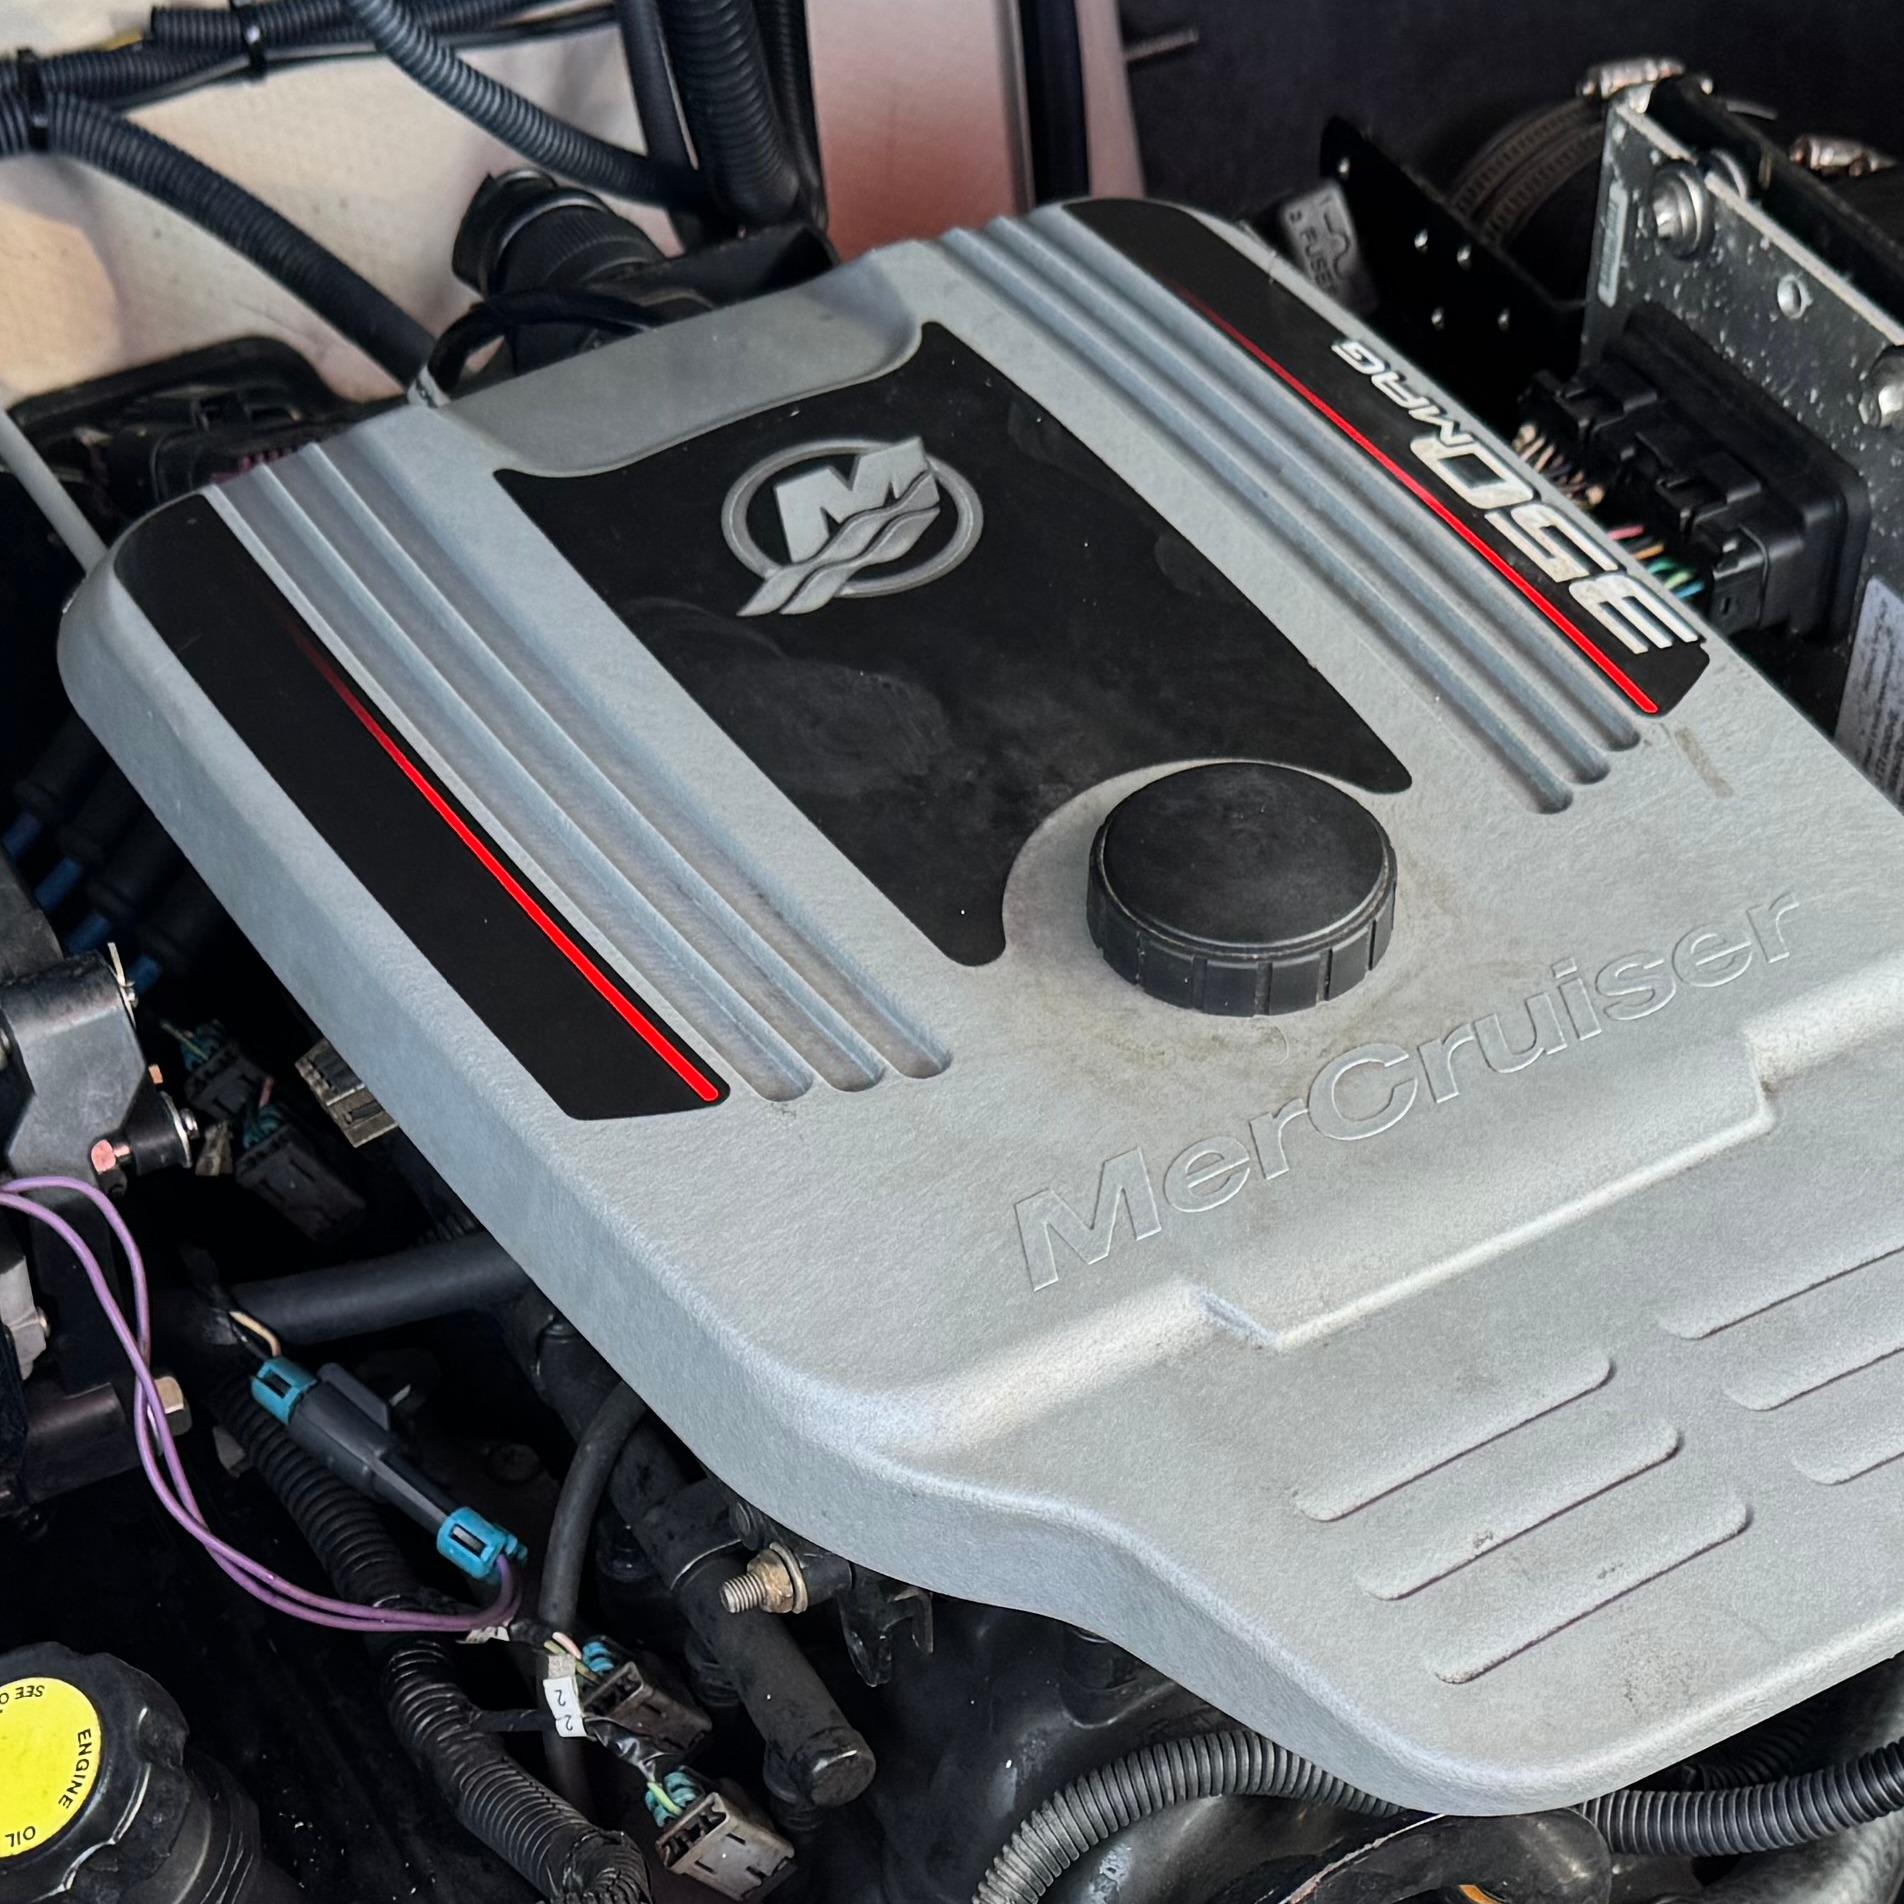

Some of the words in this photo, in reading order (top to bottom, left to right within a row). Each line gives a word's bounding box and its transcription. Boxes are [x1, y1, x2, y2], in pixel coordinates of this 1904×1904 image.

[1333, 341, 1473, 444] MAG
[1411, 435, 1699, 655] 350
[1012, 891, 1801, 1293] MerCruiser
[14, 1684, 45, 1699] SEE
[554, 1688, 566, 1706] 2
[564, 1714, 573, 1731] 2
[58, 1728, 93, 1809] ENGINE
[5, 1825, 36, 1847] OIL
